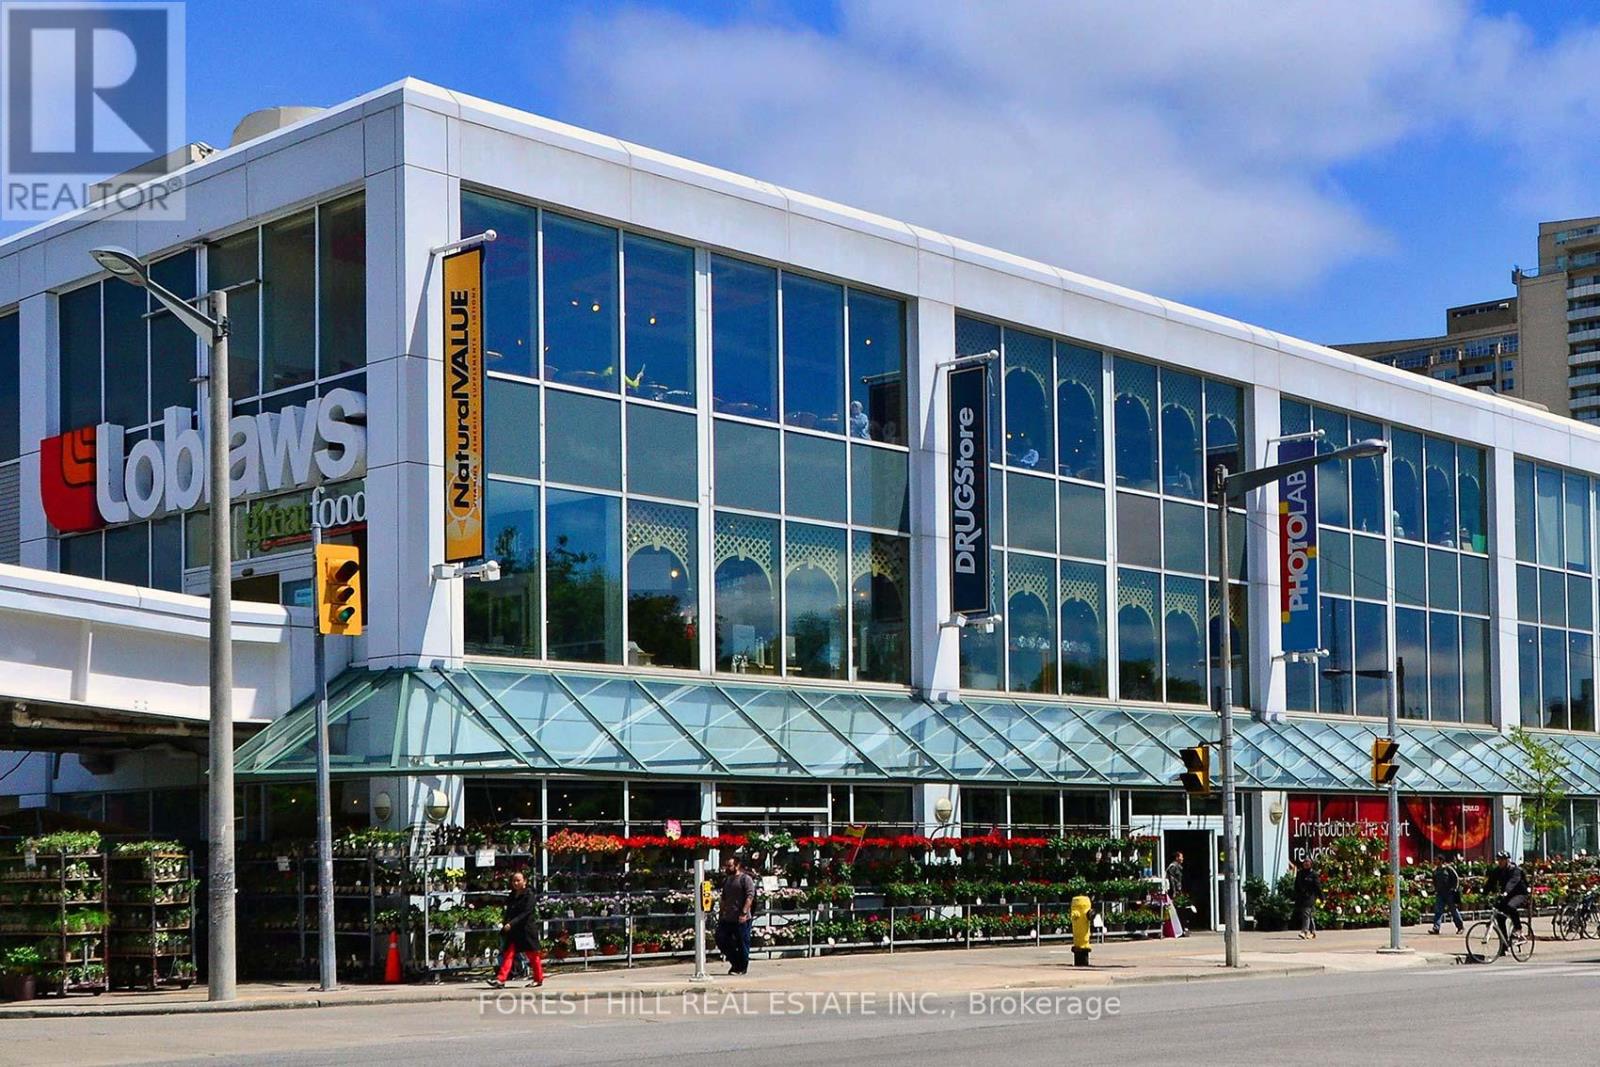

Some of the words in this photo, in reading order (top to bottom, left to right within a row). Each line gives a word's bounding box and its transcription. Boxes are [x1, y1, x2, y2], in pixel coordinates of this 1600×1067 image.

[451, 289, 470, 509] NaturalVALUE
[954, 407, 982, 574] DRUGStore
[1286, 470, 1309, 612] PHOTOLAB
